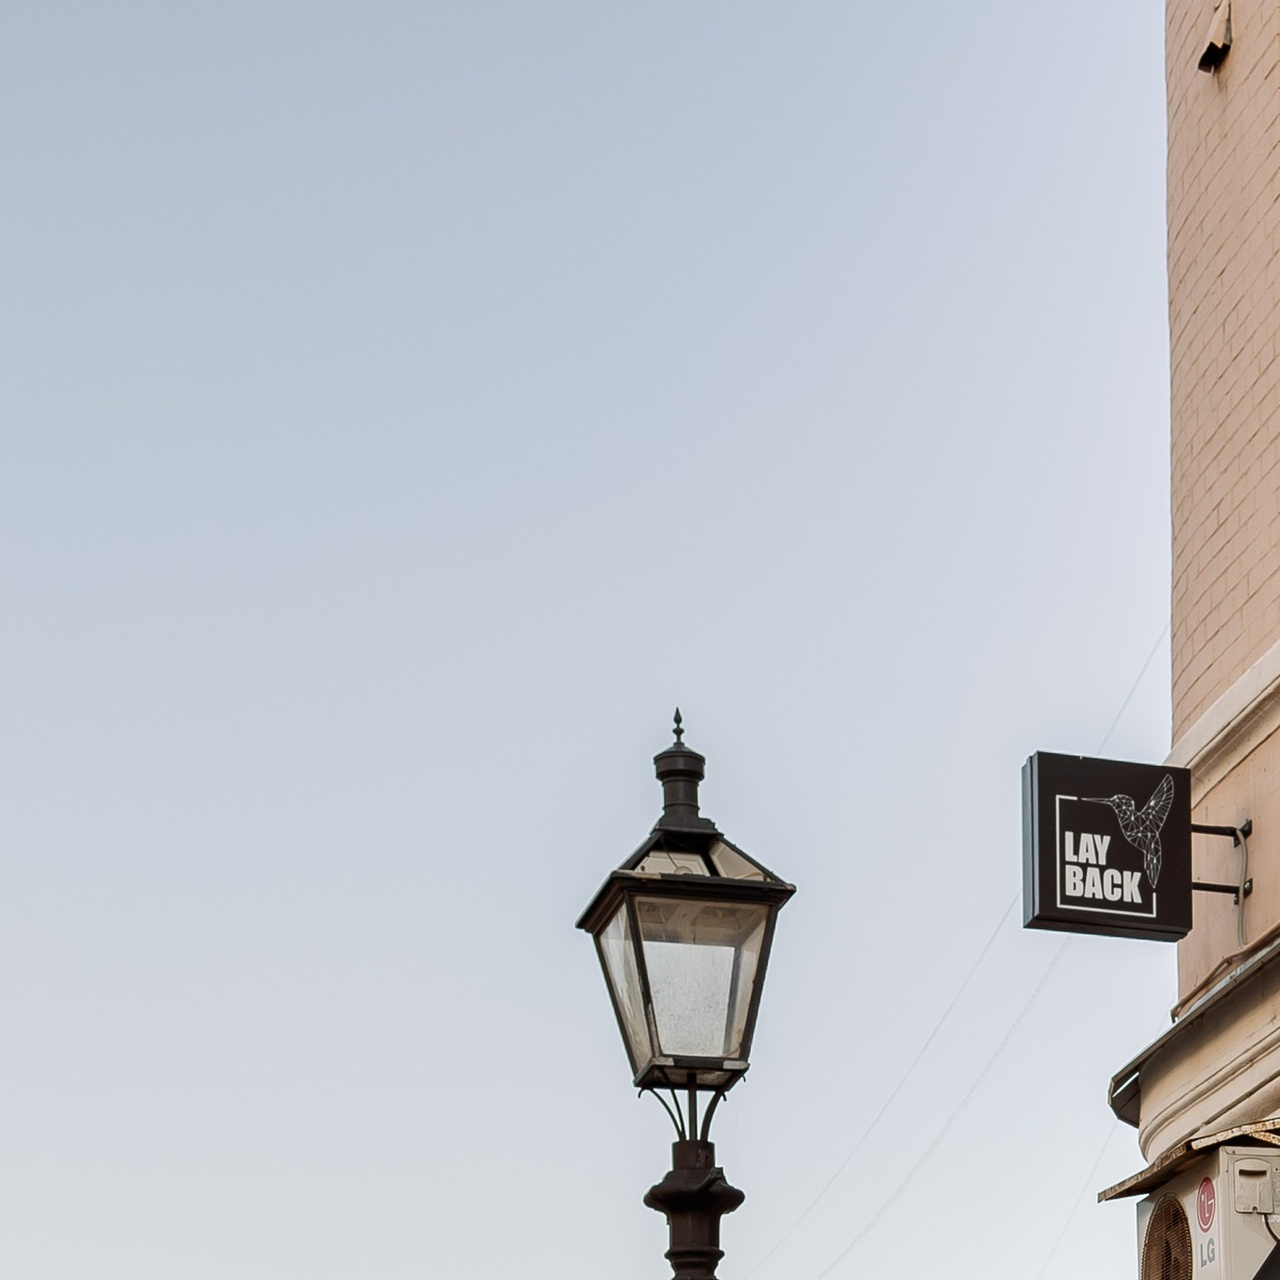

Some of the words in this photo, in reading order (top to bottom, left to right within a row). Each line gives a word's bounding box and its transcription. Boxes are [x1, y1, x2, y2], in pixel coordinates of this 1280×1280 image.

[1064, 831, 1111, 865] LAY
[1064, 865, 1143, 903] BACK
[1200, 1237, 1216, 1268] LG
